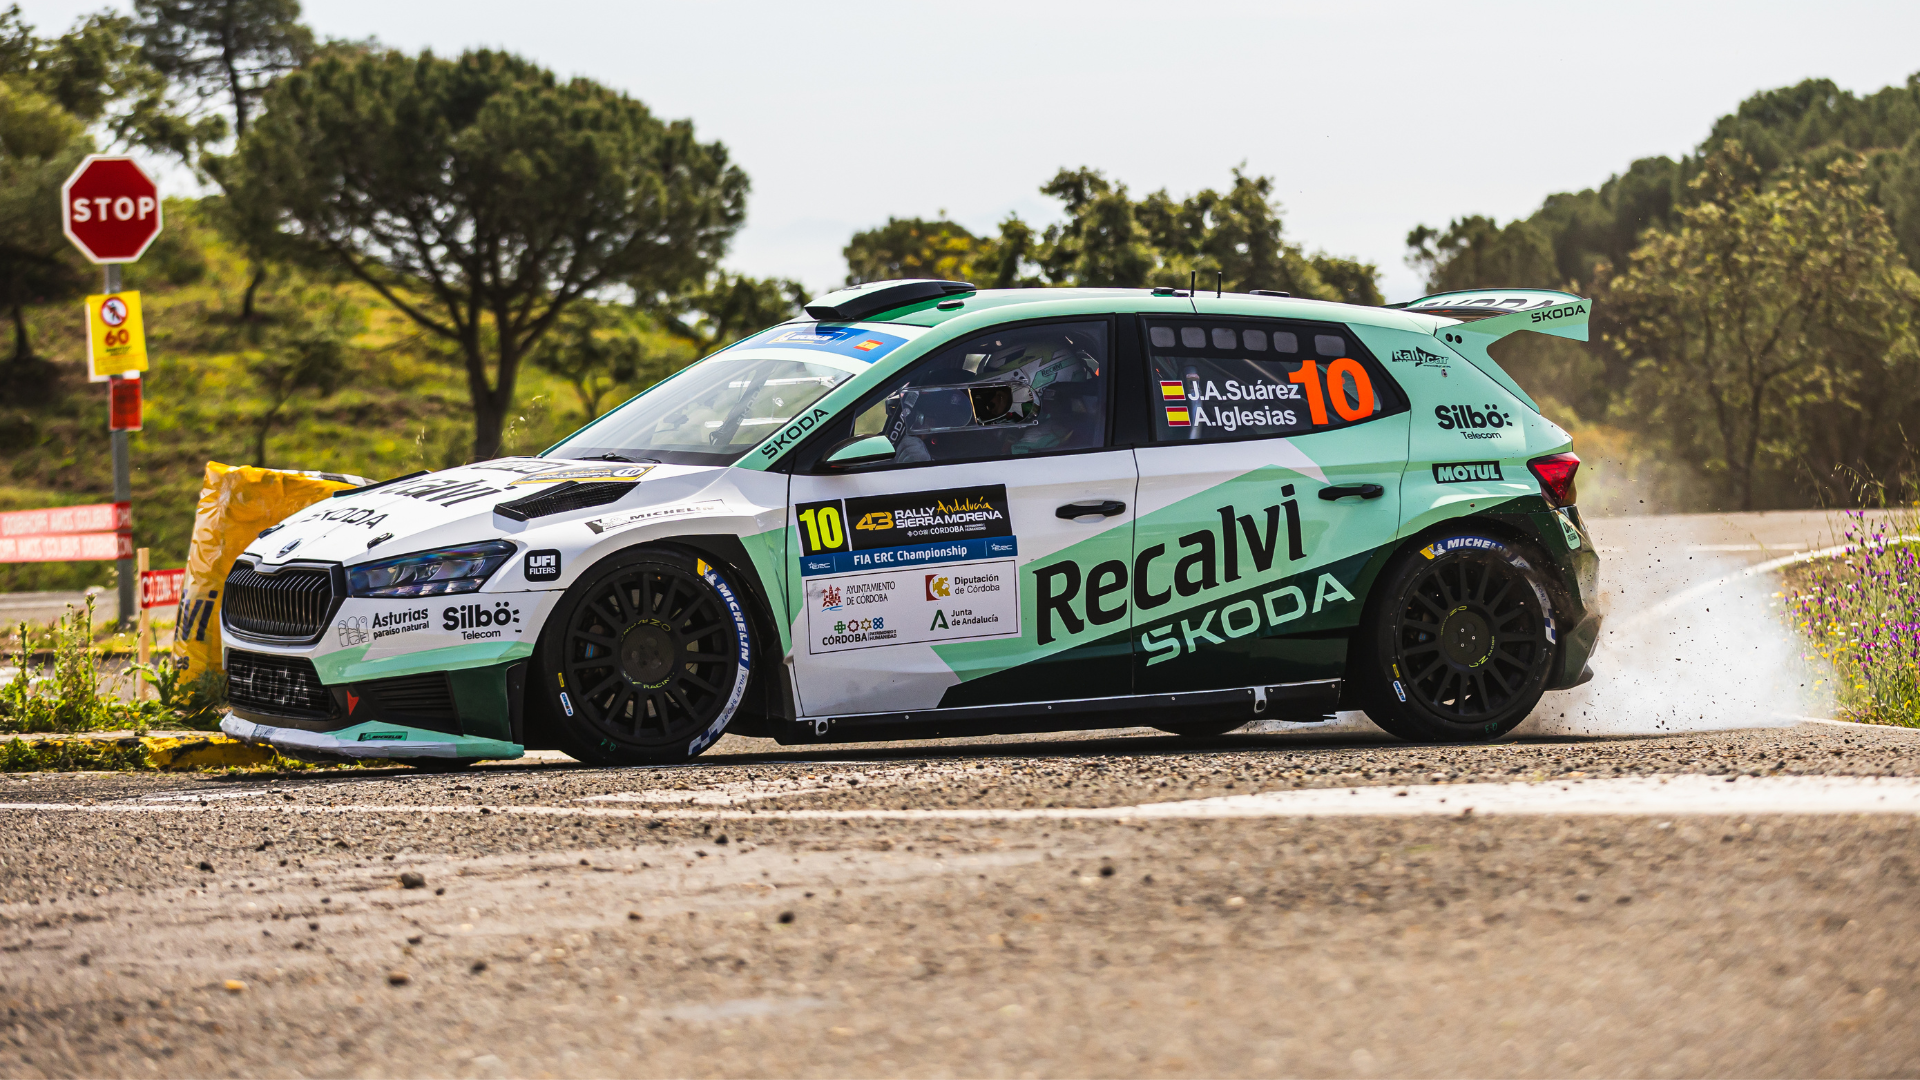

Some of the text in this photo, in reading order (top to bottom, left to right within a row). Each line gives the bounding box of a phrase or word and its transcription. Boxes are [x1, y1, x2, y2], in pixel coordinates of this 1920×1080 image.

[72, 195, 156, 223] STOP
[1531, 304, 1587, 323] SKODA
[104, 329, 130, 347] 60
[1393, 350, 1450, 365] Rallycar
[1187, 380, 1301, 401] J.A.Suárez
[1288, 358, 1375, 425] 10
[1194, 406, 1297, 431] A.Iglesias
[761, 408, 830, 460] SKODA
[1460, 431, 1502, 440] Telecom
[1437, 463, 1500, 482] MOTUL
[894, 496, 995, 520] RALLY Andalucía
[799, 506, 844, 551] 10
[855, 511, 894, 531] 43
[896, 510, 1003, 529] SIERRA MORENA
[930, 524, 965, 535] CÓRDOBA
[529, 554, 556, 568] UFI
[853, 544, 968, 566] FIA ERC Championship
[1032, 483, 1307, 646] Recalvi
[529, 566, 556, 575] FILTERS
[954, 574, 999, 586] Diputación
[846, 581, 896, 595] AYUNTAMIENTO
[954, 584, 1000, 595] de Córdoba
[846, 593, 888, 606] DE CÓRDOBA
[372, 608, 429, 629] Asturias
[717, 582, 749, 662] MICHELIN
[951, 609, 972, 617] Junta
[951, 613, 999, 626] de Andalucía
[1141, 572, 1356, 667] SKODA
[373, 620, 430, 640] paraíso natural
[461, 629, 501, 641] Telecom
[822, 632, 868, 646] CÓRDOBA
[721, 674, 745, 724] PILOT SPORT
